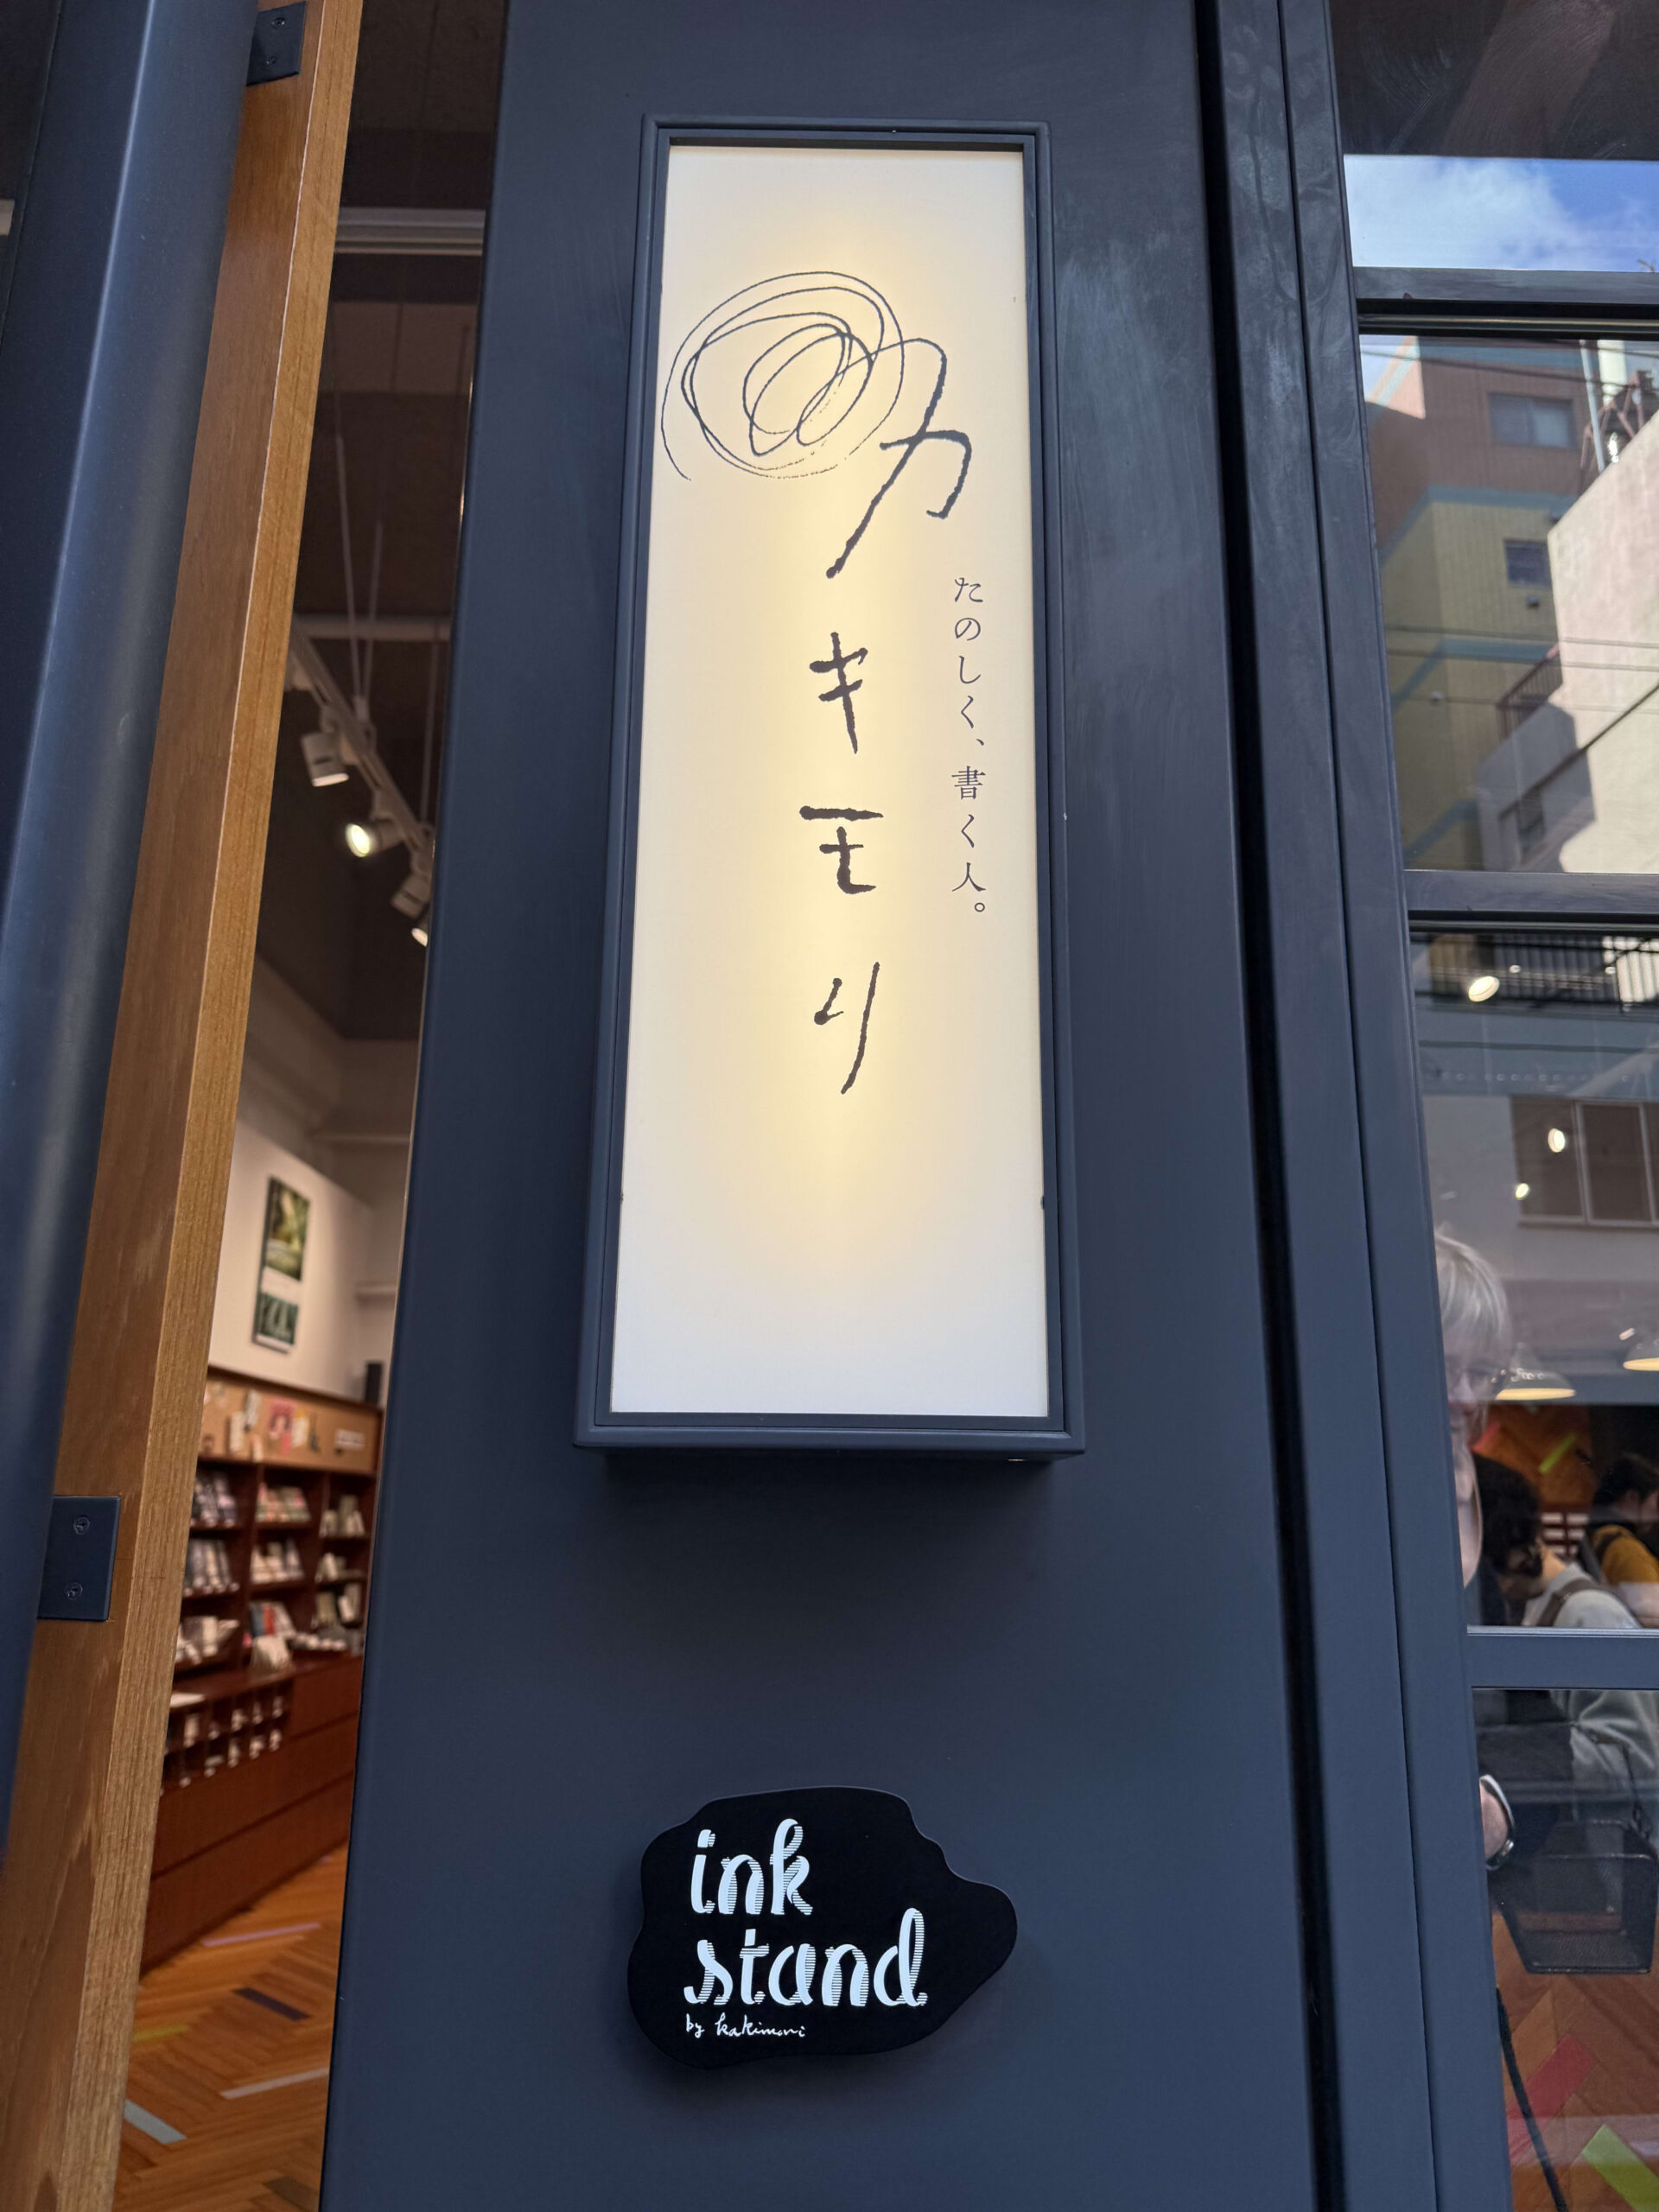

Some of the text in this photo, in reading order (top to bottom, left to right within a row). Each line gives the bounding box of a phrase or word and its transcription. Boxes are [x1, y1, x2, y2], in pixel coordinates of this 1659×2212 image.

[662, 270, 972, 1095] カキモリ
[951, 577, 987, 912] たのしく、書く人。
[690, 1818, 813, 1916] ink
[684, 1907, 928, 2006] stand
[685, 2012, 806, 2038] by kakimori
